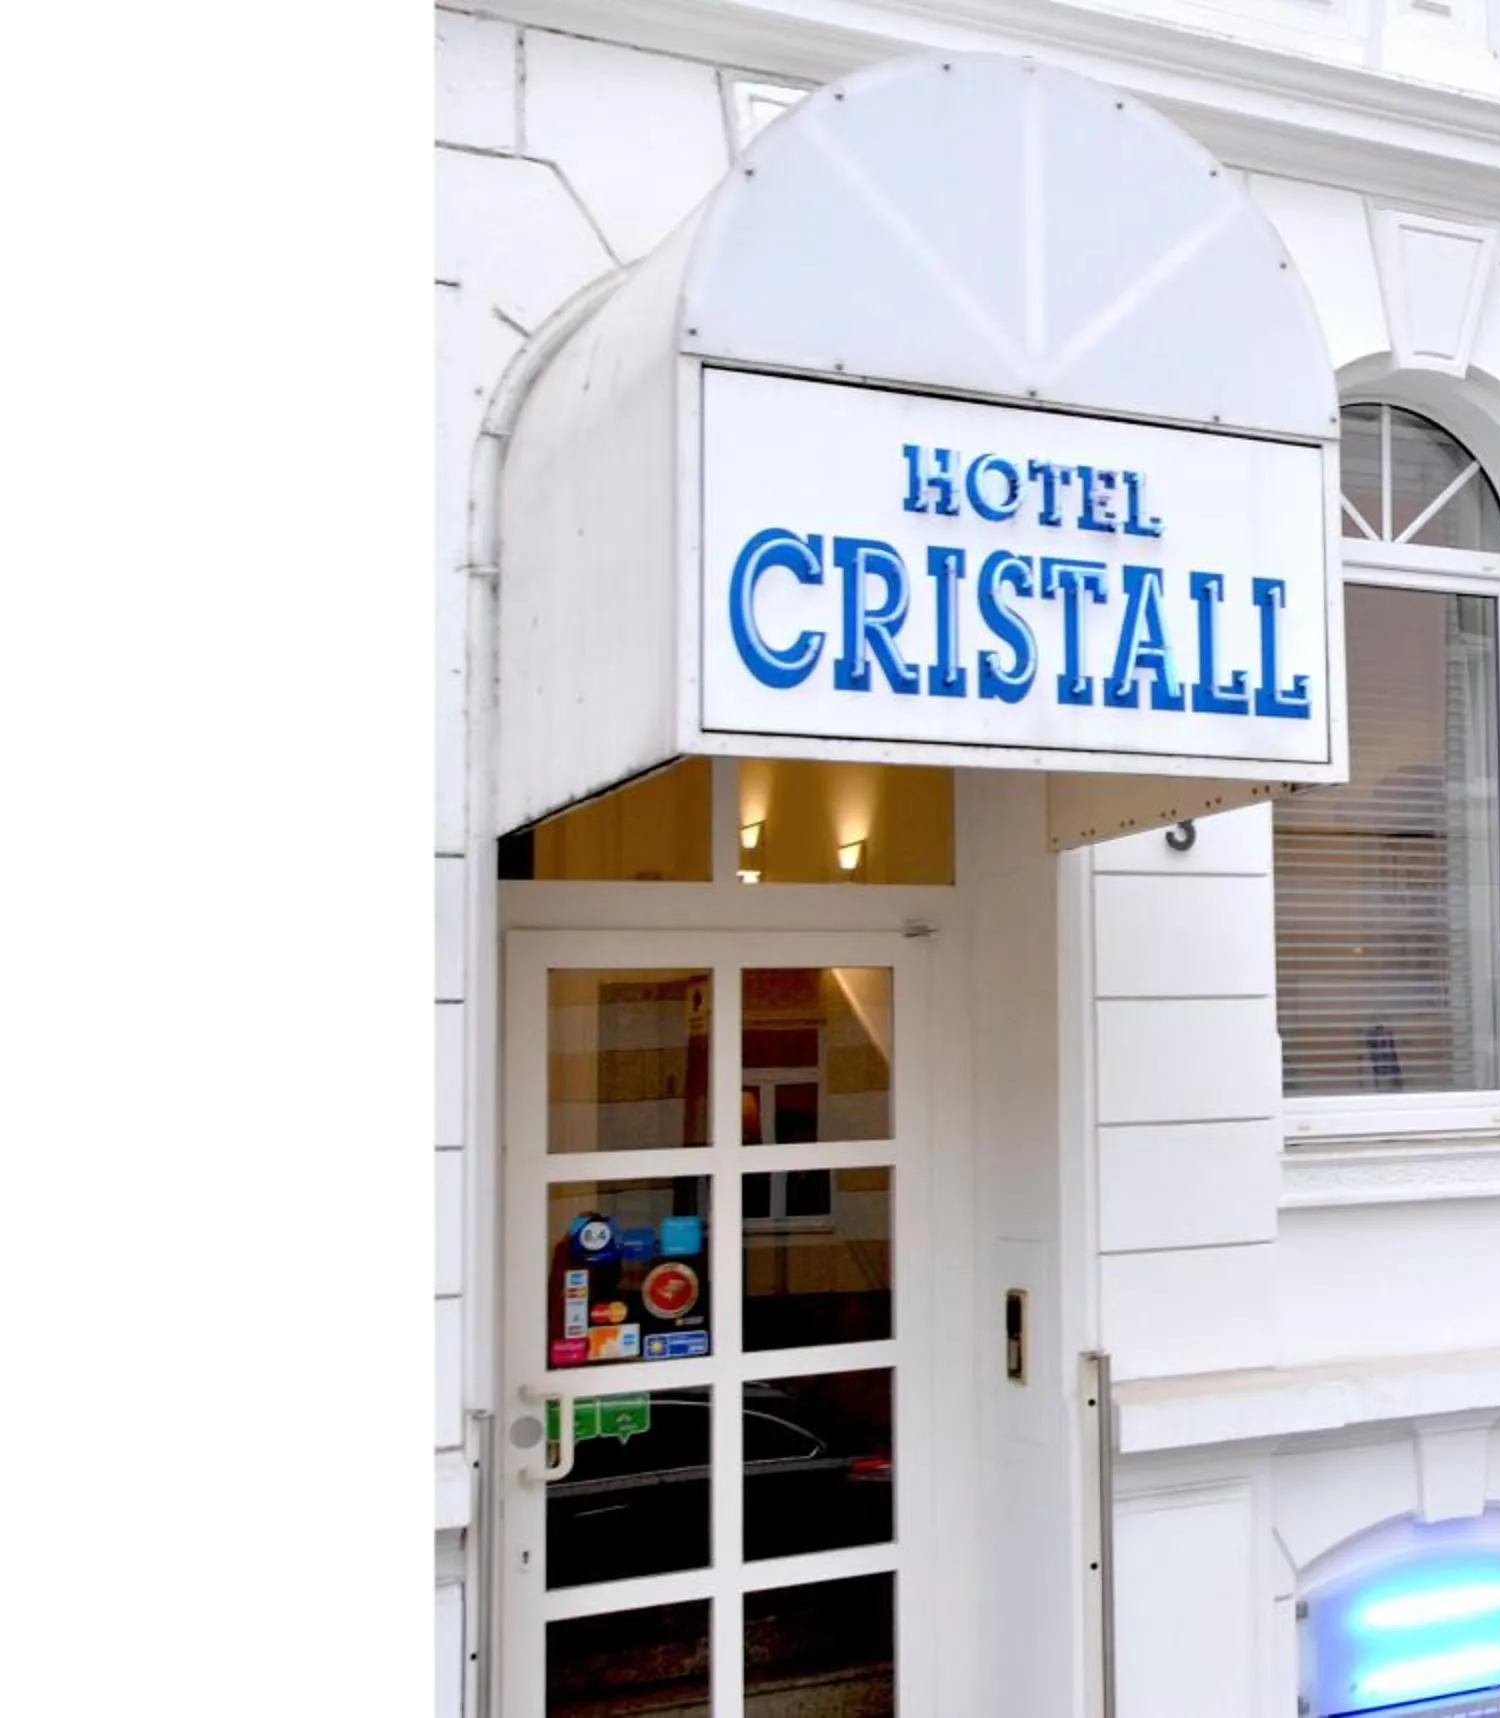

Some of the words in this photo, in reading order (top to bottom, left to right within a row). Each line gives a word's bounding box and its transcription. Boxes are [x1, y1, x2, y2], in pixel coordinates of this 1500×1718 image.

[902, 444, 1166, 538] HOTEL
[729, 527, 1312, 720] CRISTALL
[1165, 818, 1196, 852] 3
